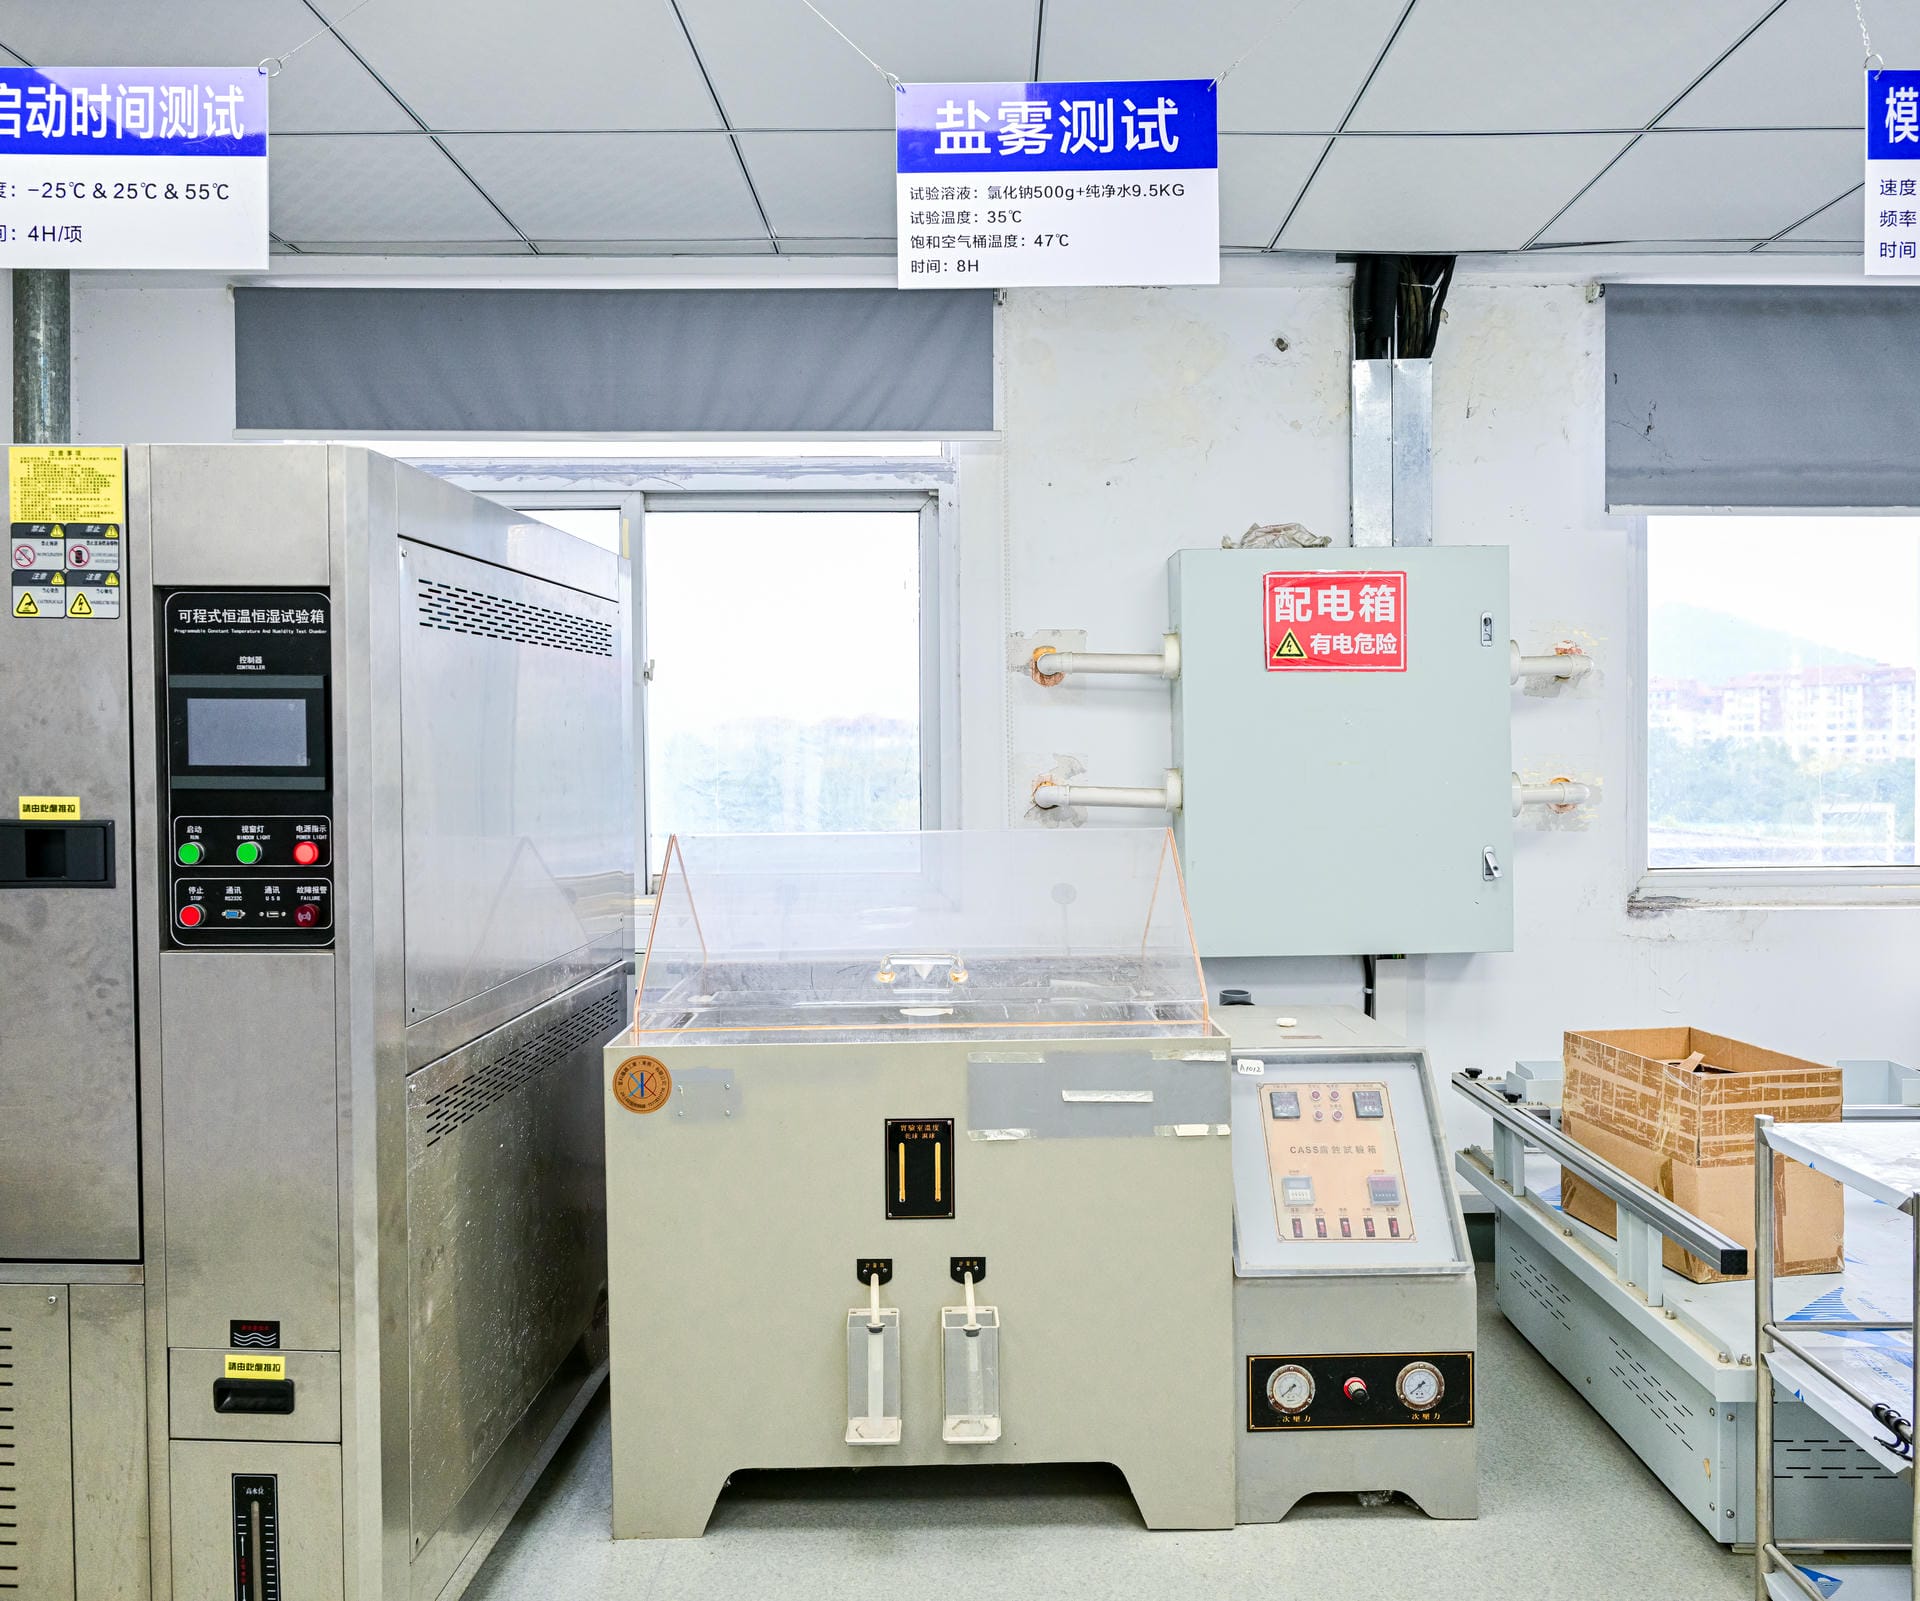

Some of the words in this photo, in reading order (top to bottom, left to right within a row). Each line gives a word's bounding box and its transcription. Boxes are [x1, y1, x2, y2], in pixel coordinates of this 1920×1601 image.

[1885, 86, 1919, 143] 模
[933, 96, 1180, 156] 盐雾测试
[92, 182, 107, 199] &
[164, 183, 179, 200] &
[1879, 179, 1917, 196] 速度
[1879, 210, 1917, 227] 频率
[1880, 241, 1916, 259] 时间
[1273, 584, 1396, 623] 配电箱
[178, 608, 325, 624] 可程式恒温恒湿试验箱
[1309, 632, 1397, 655] 有电危险
[239, 656, 263, 664] 控制器
[186, 825, 202, 834] 启动
[241, 825, 265, 833] 视窗灯
[295, 824, 327, 833] 电源指示
[188, 886, 204, 895] 停止
[225, 886, 242, 895] 通讯
[264, 886, 281, 895] 通讯
[296, 886, 328, 895] 故障报警
